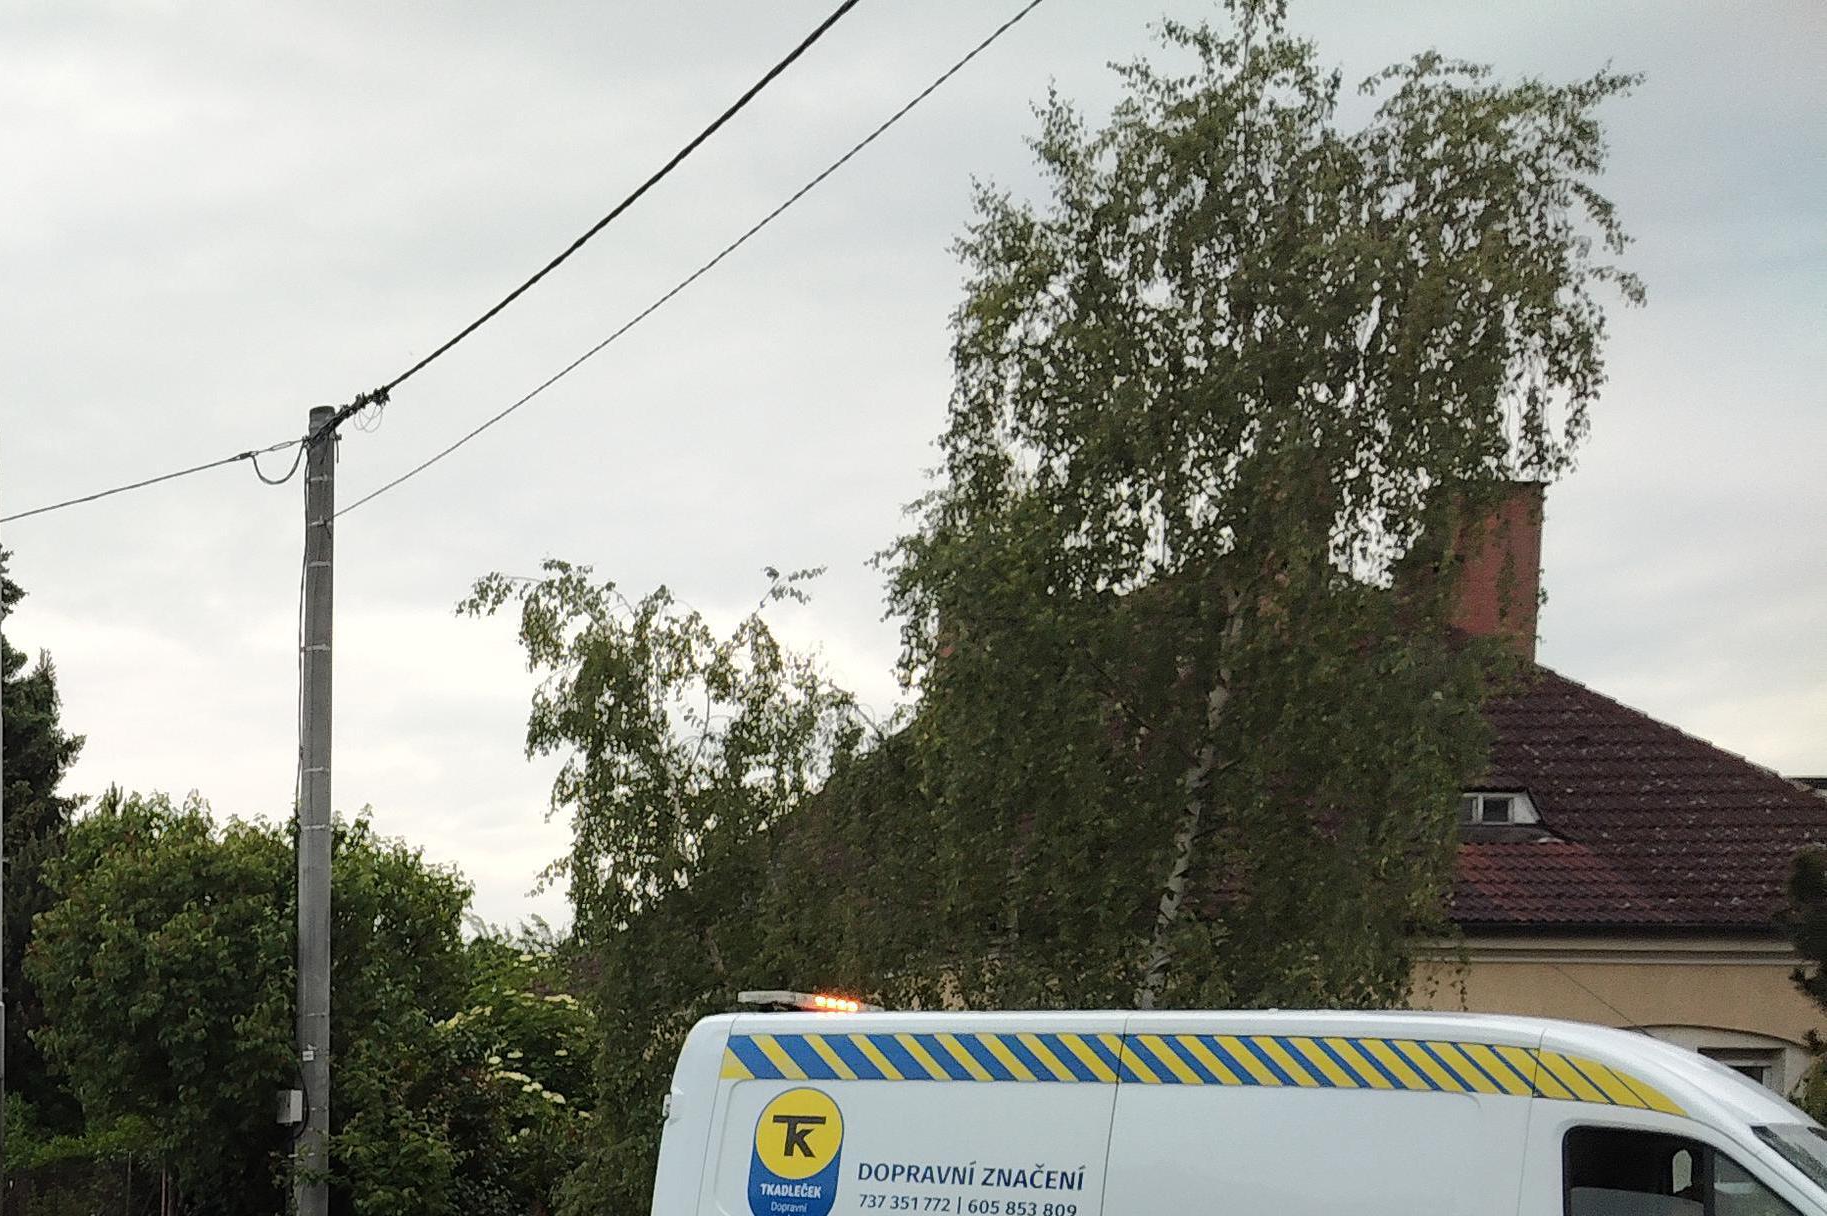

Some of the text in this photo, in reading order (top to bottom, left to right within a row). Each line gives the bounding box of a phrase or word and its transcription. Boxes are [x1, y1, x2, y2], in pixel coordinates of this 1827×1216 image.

[857, 1160, 1086, 1191] DOPRAVNÍ ZNAČENÍ
[760, 1182, 822, 1199] TKADLEČEK
[770, 1200, 808, 1213] Dopravní
[858, 1193, 886, 1209] 737
[889, 1195, 918, 1211] 351
[923, 1196, 950, 1212] 772
[967, 1199, 1000, 1215] 605
[1005, 1201, 1037, 1216] 853
